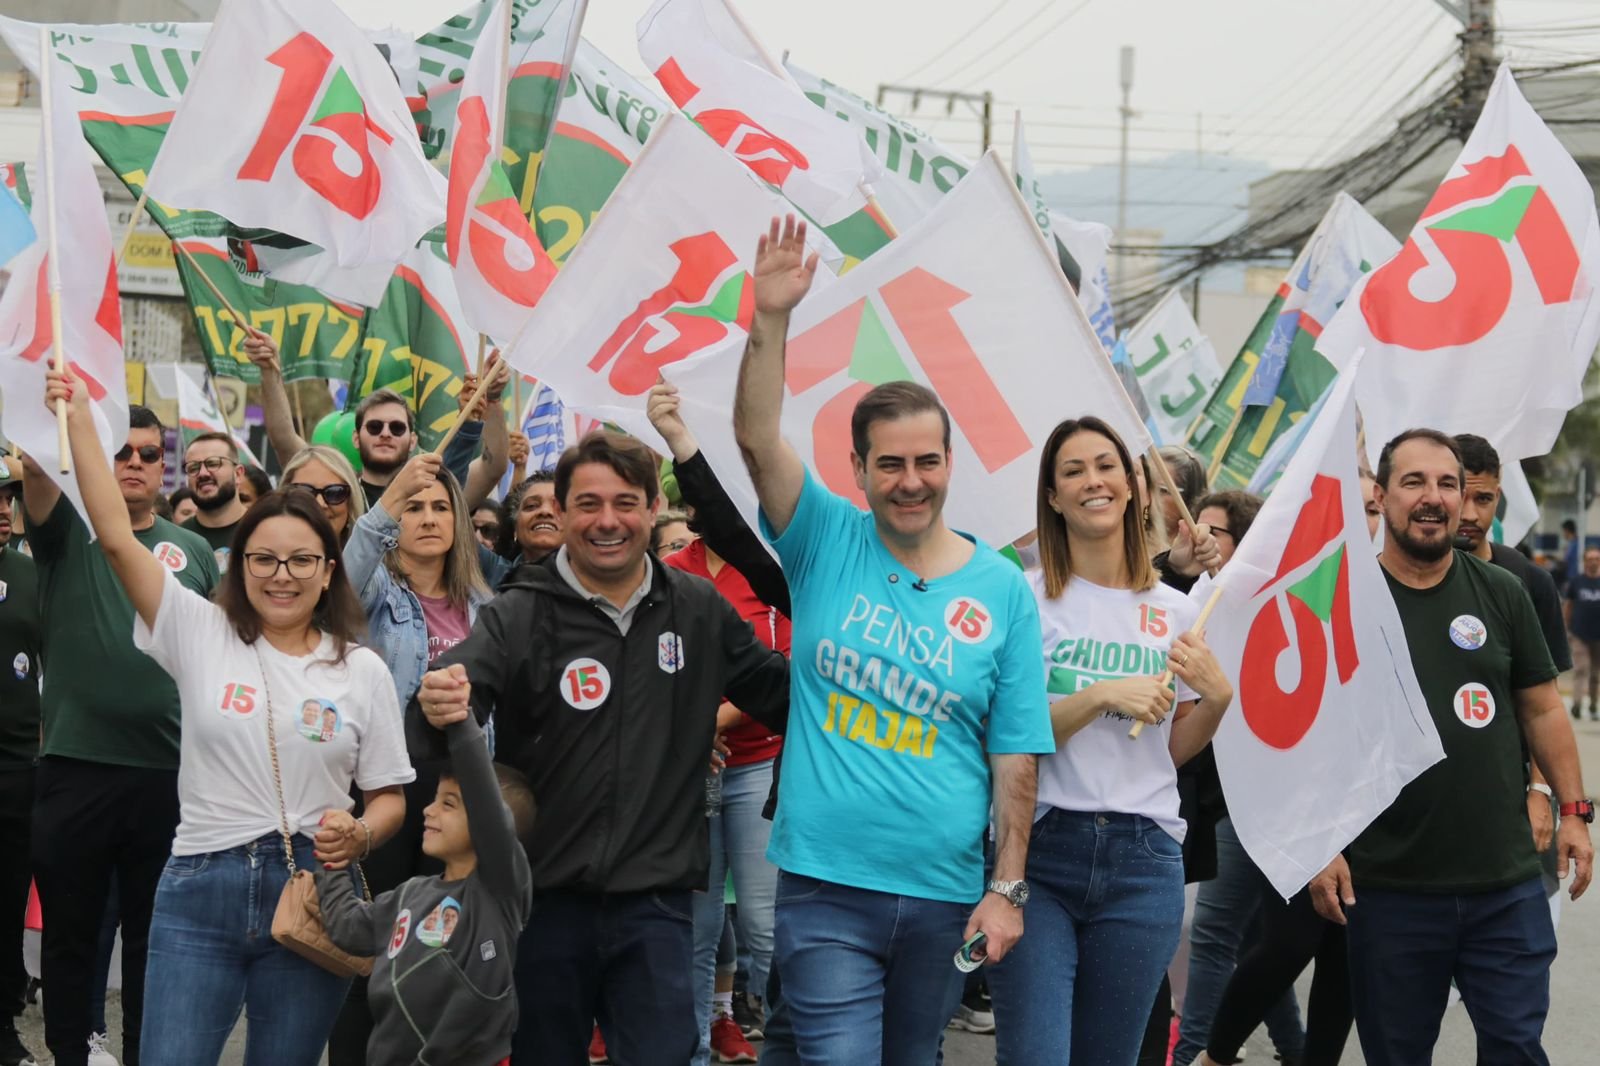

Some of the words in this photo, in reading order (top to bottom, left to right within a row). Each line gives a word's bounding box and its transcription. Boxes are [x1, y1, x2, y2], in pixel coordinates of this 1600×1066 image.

[237, 31, 394, 221] 15
[1359, 143, 1580, 351] 15
[195, 303, 359, 363] 12777
[587, 230, 755, 396] 15
[158, 544, 182, 569] 15
[841, 594, 953, 677] PENSA
[949, 600, 988, 638] 15
[1138, 603, 1168, 638] 15
[1239, 473, 1360, 750] 15
[221, 683, 257, 714] 15
[566, 665, 604, 703] 15
[815, 638, 963, 722] GRANDE
[1460, 689, 1489, 720] 15
